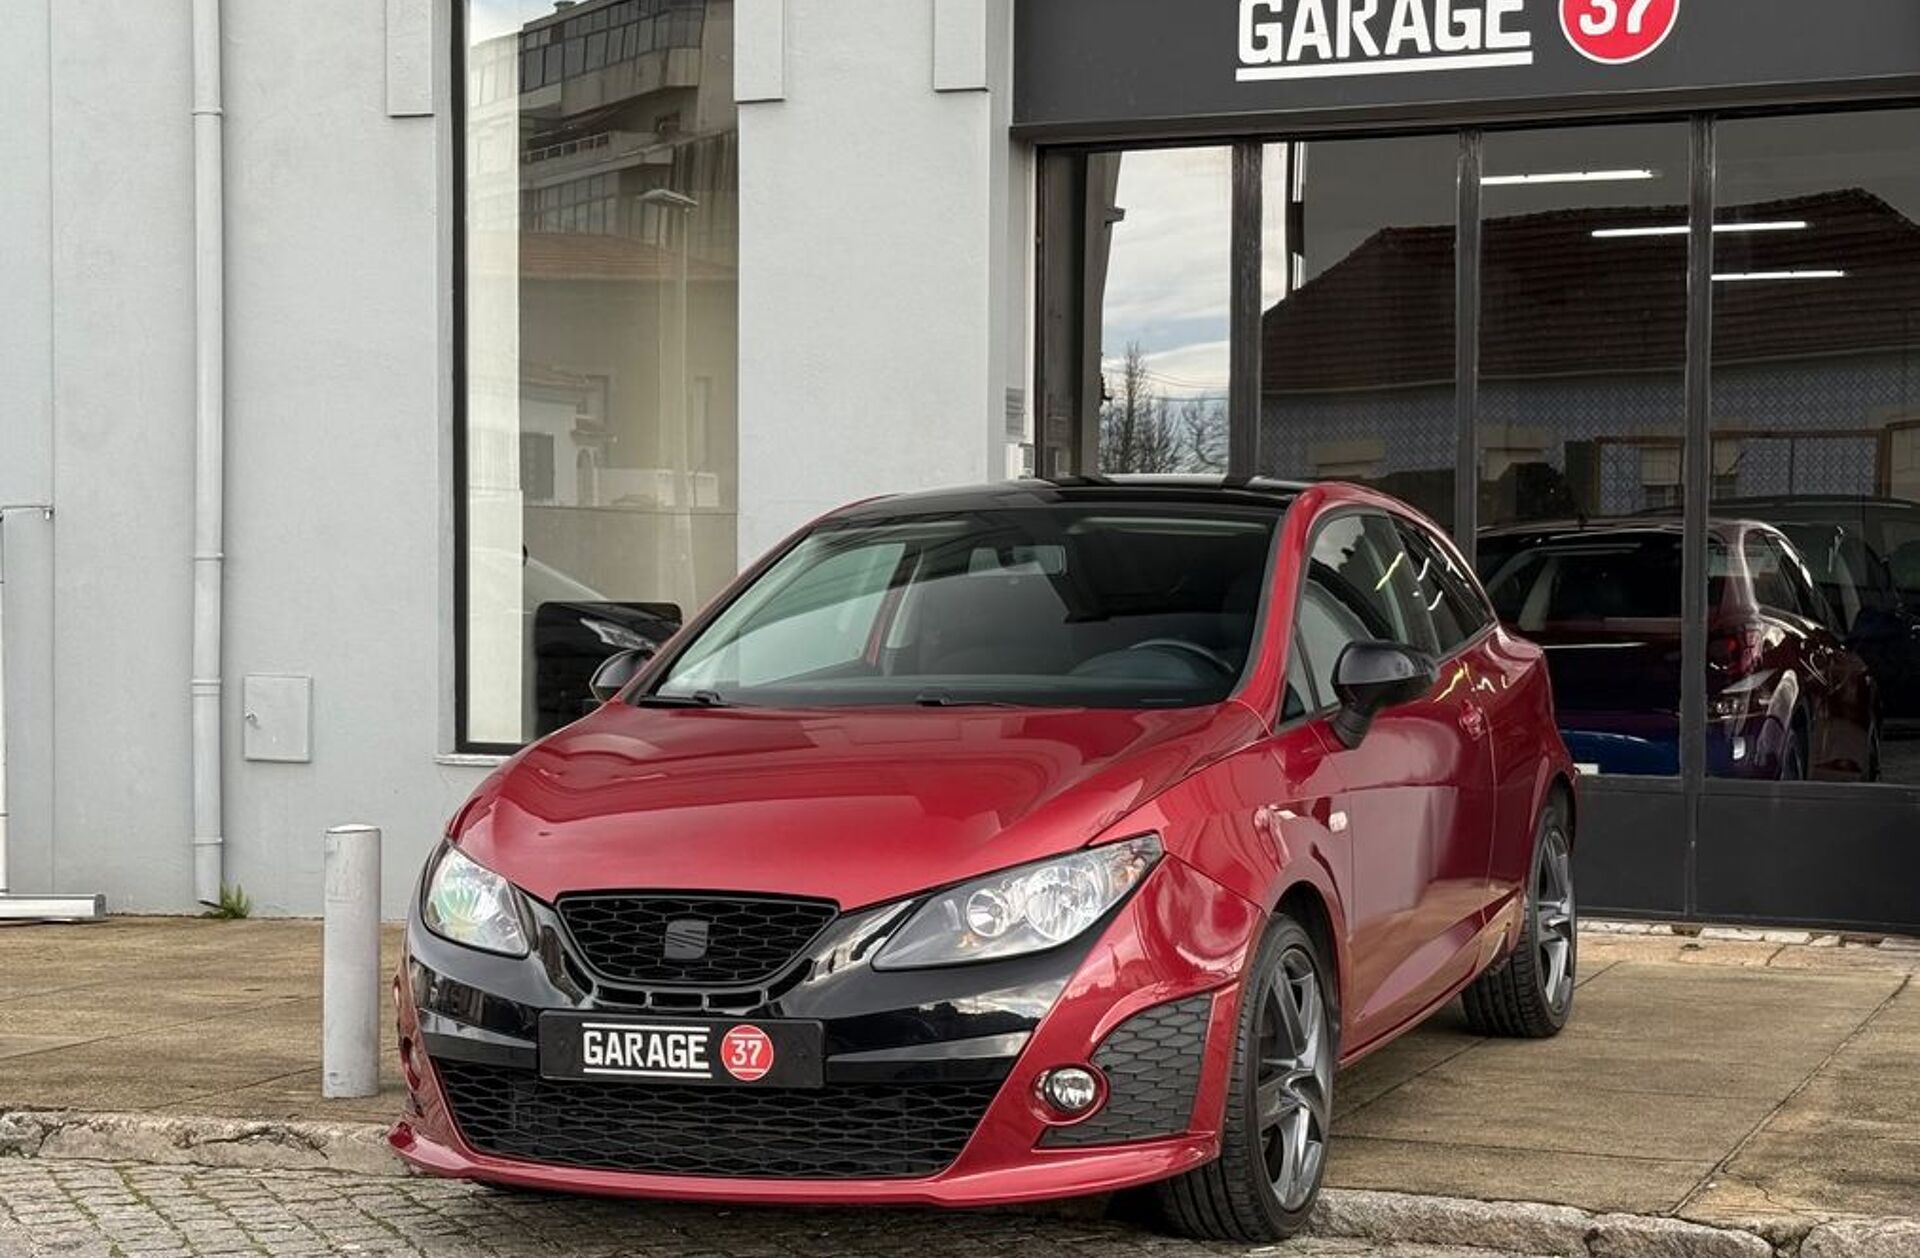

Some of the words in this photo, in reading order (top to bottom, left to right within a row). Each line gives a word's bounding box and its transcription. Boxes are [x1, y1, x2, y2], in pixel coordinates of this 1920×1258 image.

[1239, 0, 1531, 64] GARAGE
[583, 1031, 709, 1069] GARAGE
[731, 1039, 762, 1066] 37
